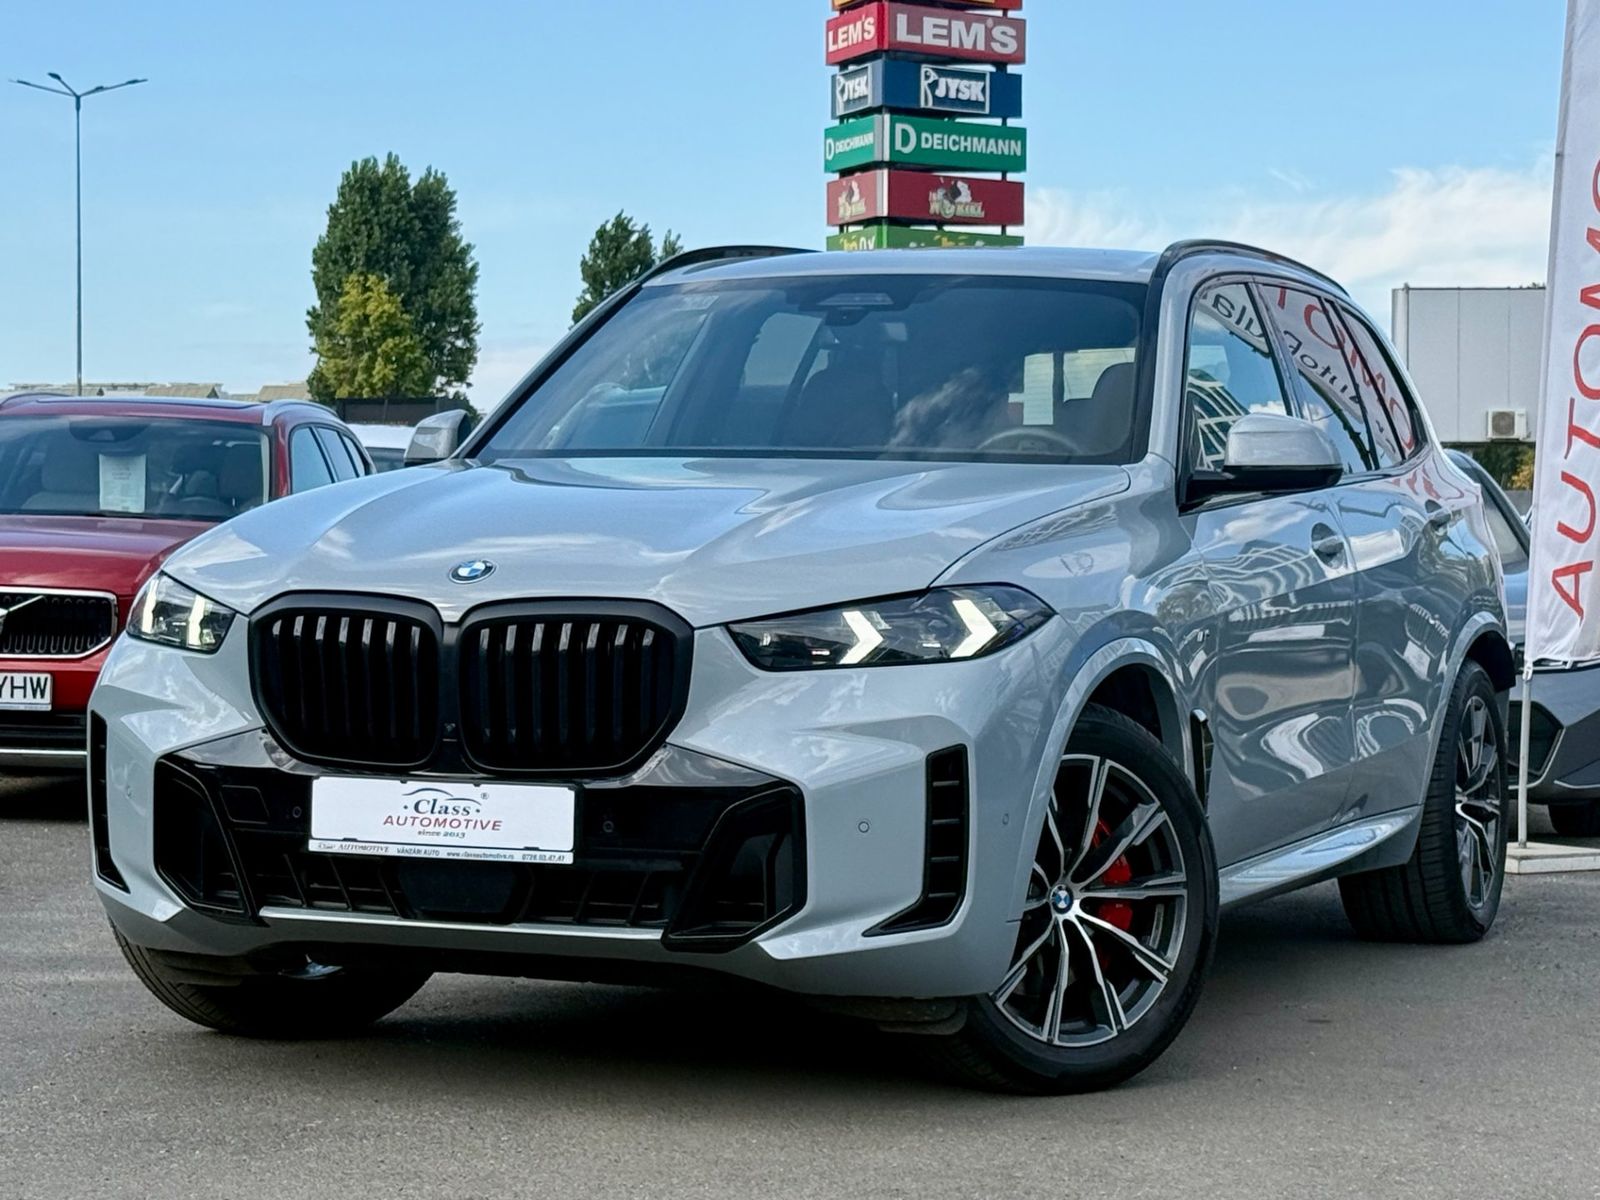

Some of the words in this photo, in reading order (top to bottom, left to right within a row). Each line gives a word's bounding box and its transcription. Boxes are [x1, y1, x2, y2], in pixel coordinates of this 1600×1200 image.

[828, 14, 876, 53] LEM'S
[896, 13, 1018, 54] LEM'S
[842, 75, 868, 102] JYSK
[935, 77, 985, 102] JYSK
[835, 132, 874, 154] DEICHMANN
[895, 123, 917, 154] D
[921, 132, 1022, 157] DEICHMANN
[413, 799, 471, 816] Class
[383, 815, 503, 831] AUTOMOTIVE
[418, 829, 441, 837] since
[443, 831, 466, 839] 2013
[423, 849, 440, 857] AUTO
